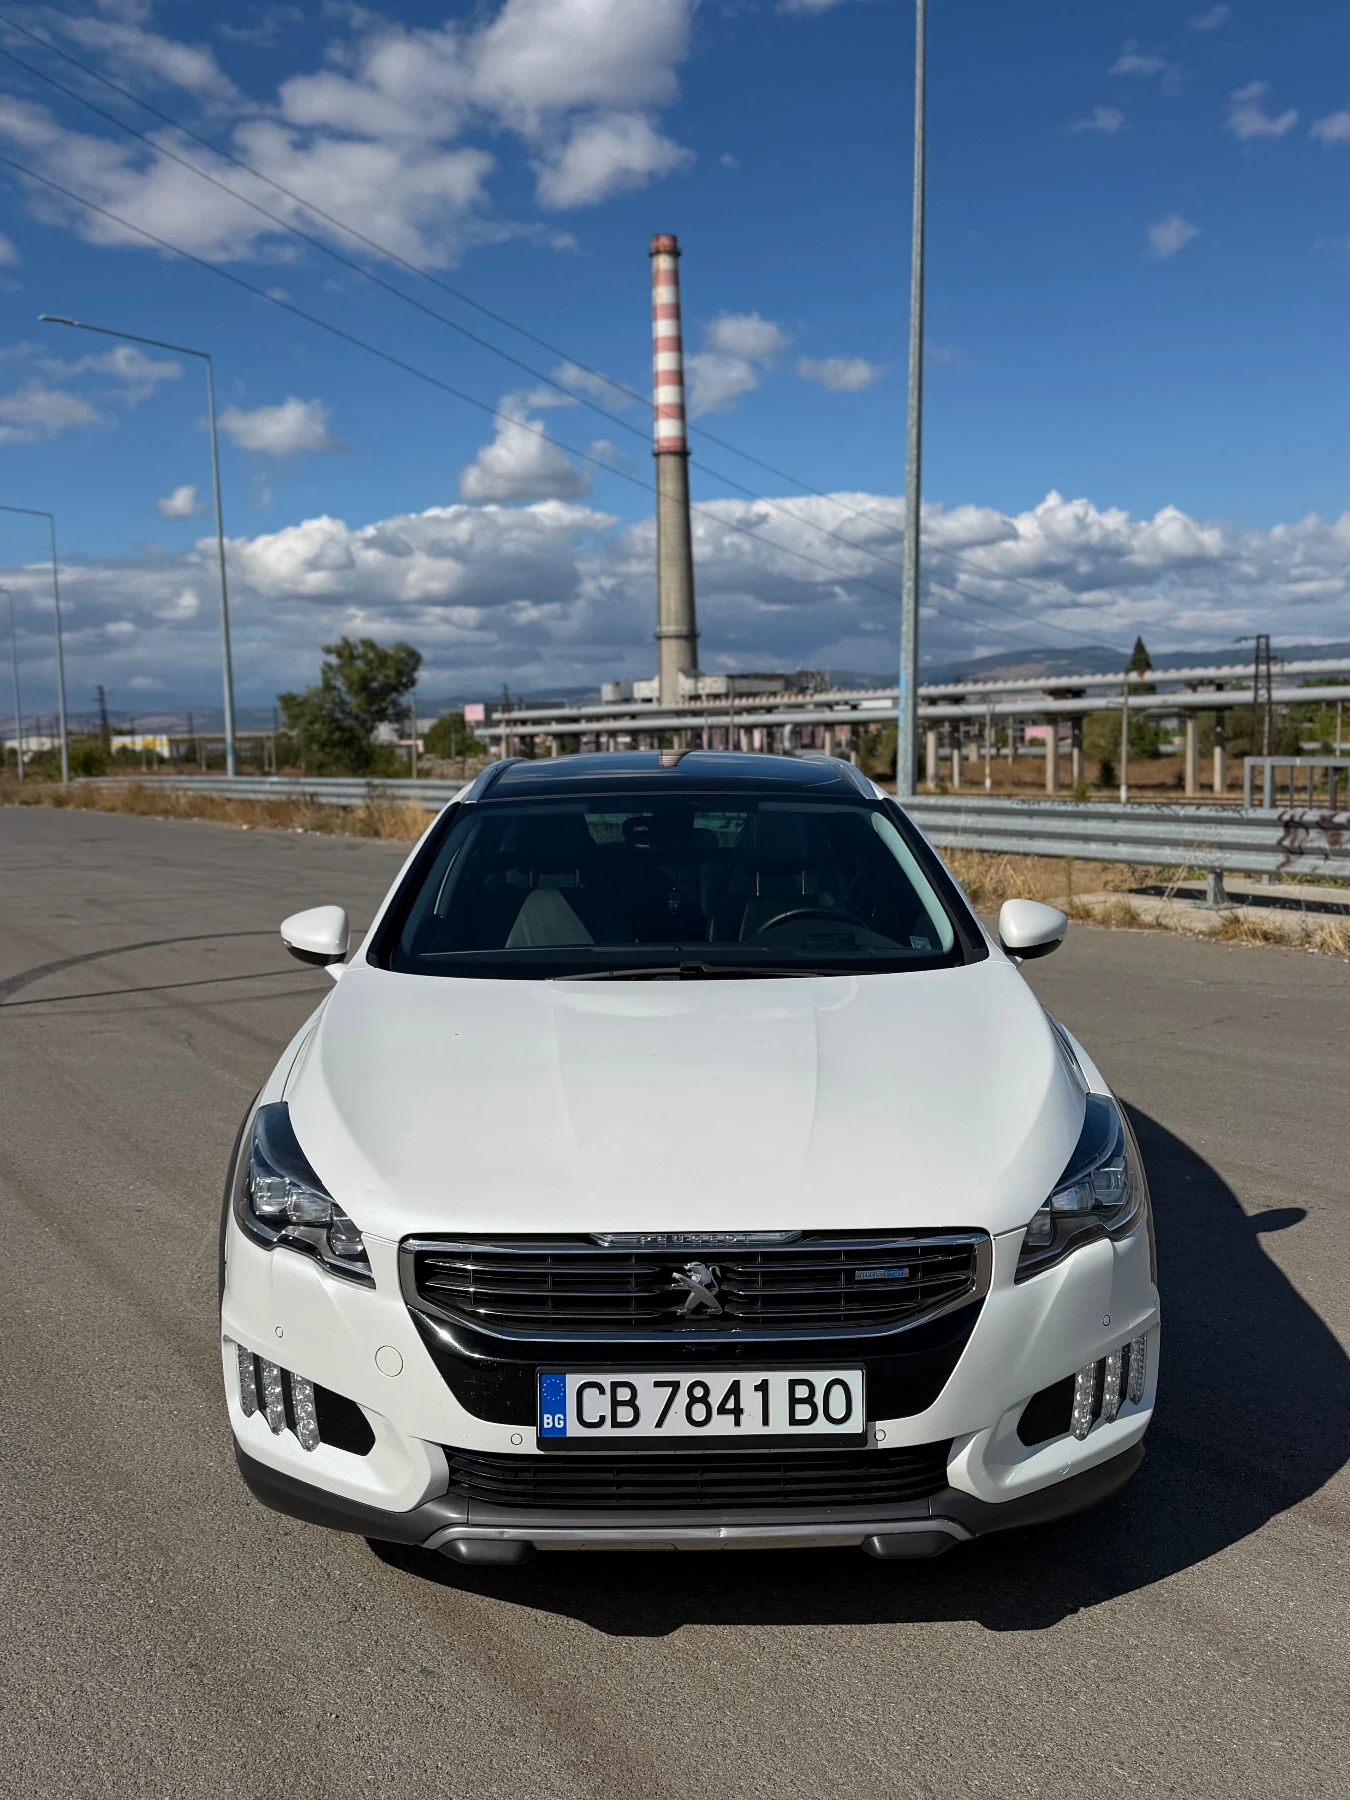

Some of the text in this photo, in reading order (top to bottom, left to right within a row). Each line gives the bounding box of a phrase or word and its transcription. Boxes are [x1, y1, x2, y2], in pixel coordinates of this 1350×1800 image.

[639, 1233, 751, 1244] PEUGEOT
[575, 1380, 640, 1429] CB
[652, 1378, 770, 1429] 7841
[542, 1413, 565, 1429] BG
